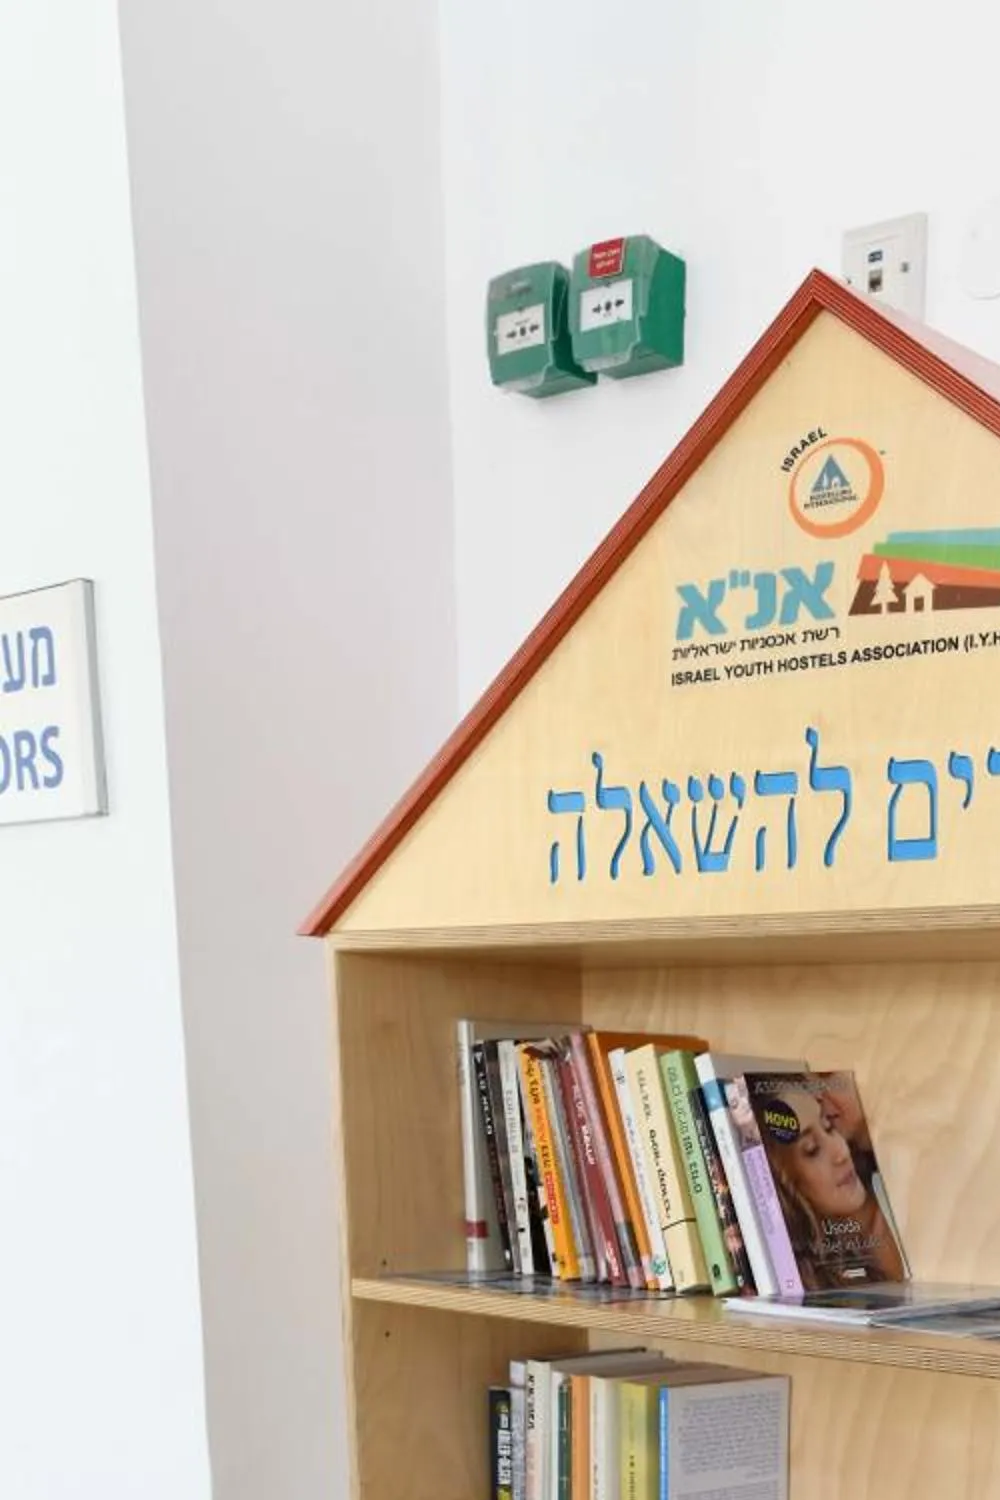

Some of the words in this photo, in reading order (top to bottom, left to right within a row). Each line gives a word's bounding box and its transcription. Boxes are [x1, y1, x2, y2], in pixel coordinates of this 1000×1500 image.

[781, 426, 828, 472] ISRAEL
[740, 633, 797, 650] אכסניות
[801, 627, 841, 643] רשת
[671, 642, 738, 661] ישראליות
[671, 667, 721, 687] ISRAEL
[724, 661, 774, 680] YOUTH
[777, 652, 848, 674] HOSTELS
[850, 636, 959, 663] ASSOCIATION
[546, 726, 852, 883] להשאלה
